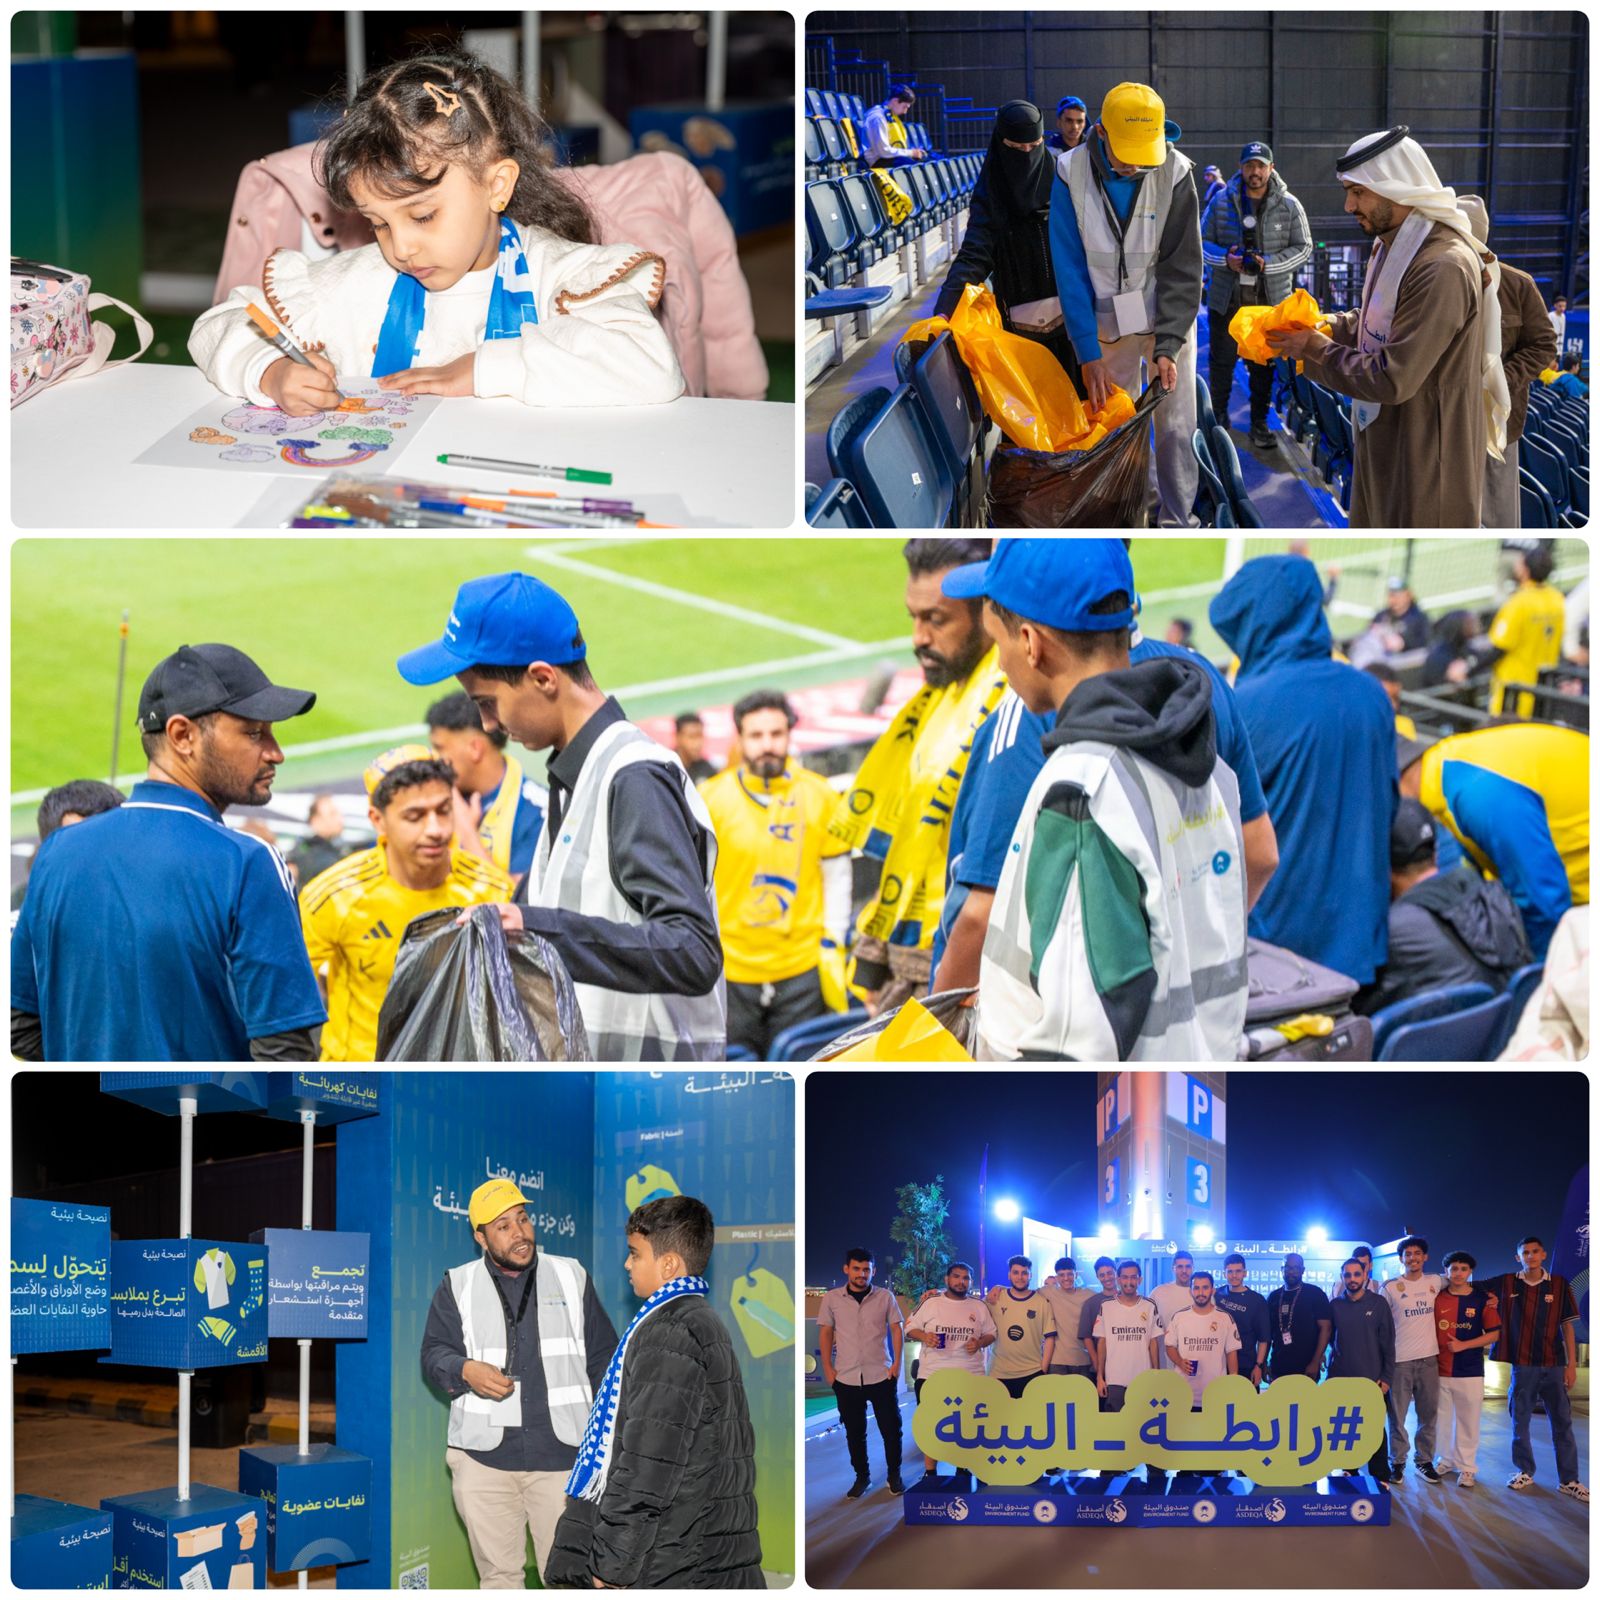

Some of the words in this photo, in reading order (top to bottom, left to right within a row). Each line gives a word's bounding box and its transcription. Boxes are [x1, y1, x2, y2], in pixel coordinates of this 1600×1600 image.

[346, 1085, 378, 1099] نفايات
[1105, 1088, 1115, 1132] P
[1194, 1084, 1209, 1126] P
[518, 1170, 544, 1191] انضم
[1105, 1164, 1115, 1203] 3
[1194, 1164, 1209, 1203] 3
[50, 1206, 75, 1223] بيئية
[76, 1209, 107, 1224] نصيحة
[538, 1212, 557, 1235] جزء
[558, 1213, 576, 1237] وكن
[732, 1230, 758, 1239] Plastic
[142, 1249, 160, 1261] بيئية
[161, 1249, 186, 1261] نصيحة
[50, 1280, 82, 1298] الأوراق
[268, 1277, 303, 1292] بواسطة
[305, 1279, 340, 1292] مراقبتها
[342, 1284, 365, 1294] ويتم
[84, 1285, 107, 1299] وضع
[152, 1287, 186, 1306] تبرع
[268, 1293, 322, 1305] استشعار
[324, 1293, 364, 1308] أجهزة
[39, 1303, 79, 1318] النفايات
[80, 1303, 107, 1318] حاوية
[117, 1307, 141, 1318] رميها
[142, 1307, 154, 1318] بدل
[155, 1307, 186, 1318] الصالحة
[328, 1308, 363, 1320] متقدمة
[936, 1325, 975, 1335] Emirates
[1111, 1326, 1147, 1335] Emirates
[1450, 1321, 1473, 1331] Spotify
[1183, 1337, 1219, 1345] Emirates
[236, 1342, 268, 1358] الأقمشة
[282, 1499, 322, 1515] عضوية
[324, 1494, 366, 1511] نفايات
[984, 1502, 1003, 1511] البيئة
[1004, 1503, 1030, 1512] صندوق
[1143, 1503, 1163, 1511] البيئة
[1163, 1504, 1189, 1512] صندوق
[1321, 1503, 1348, 1511] صندوق
[919, 1509, 947, 1518] ASDEQA
[1076, 1512, 1104, 1520] ASDEQA
[82, 1523, 111, 1540] نصيحة
[132, 1517, 147, 1533] بيئية
[145, 1526, 166, 1538] نصيحة
[58, 1534, 81, 1548] بيئية
